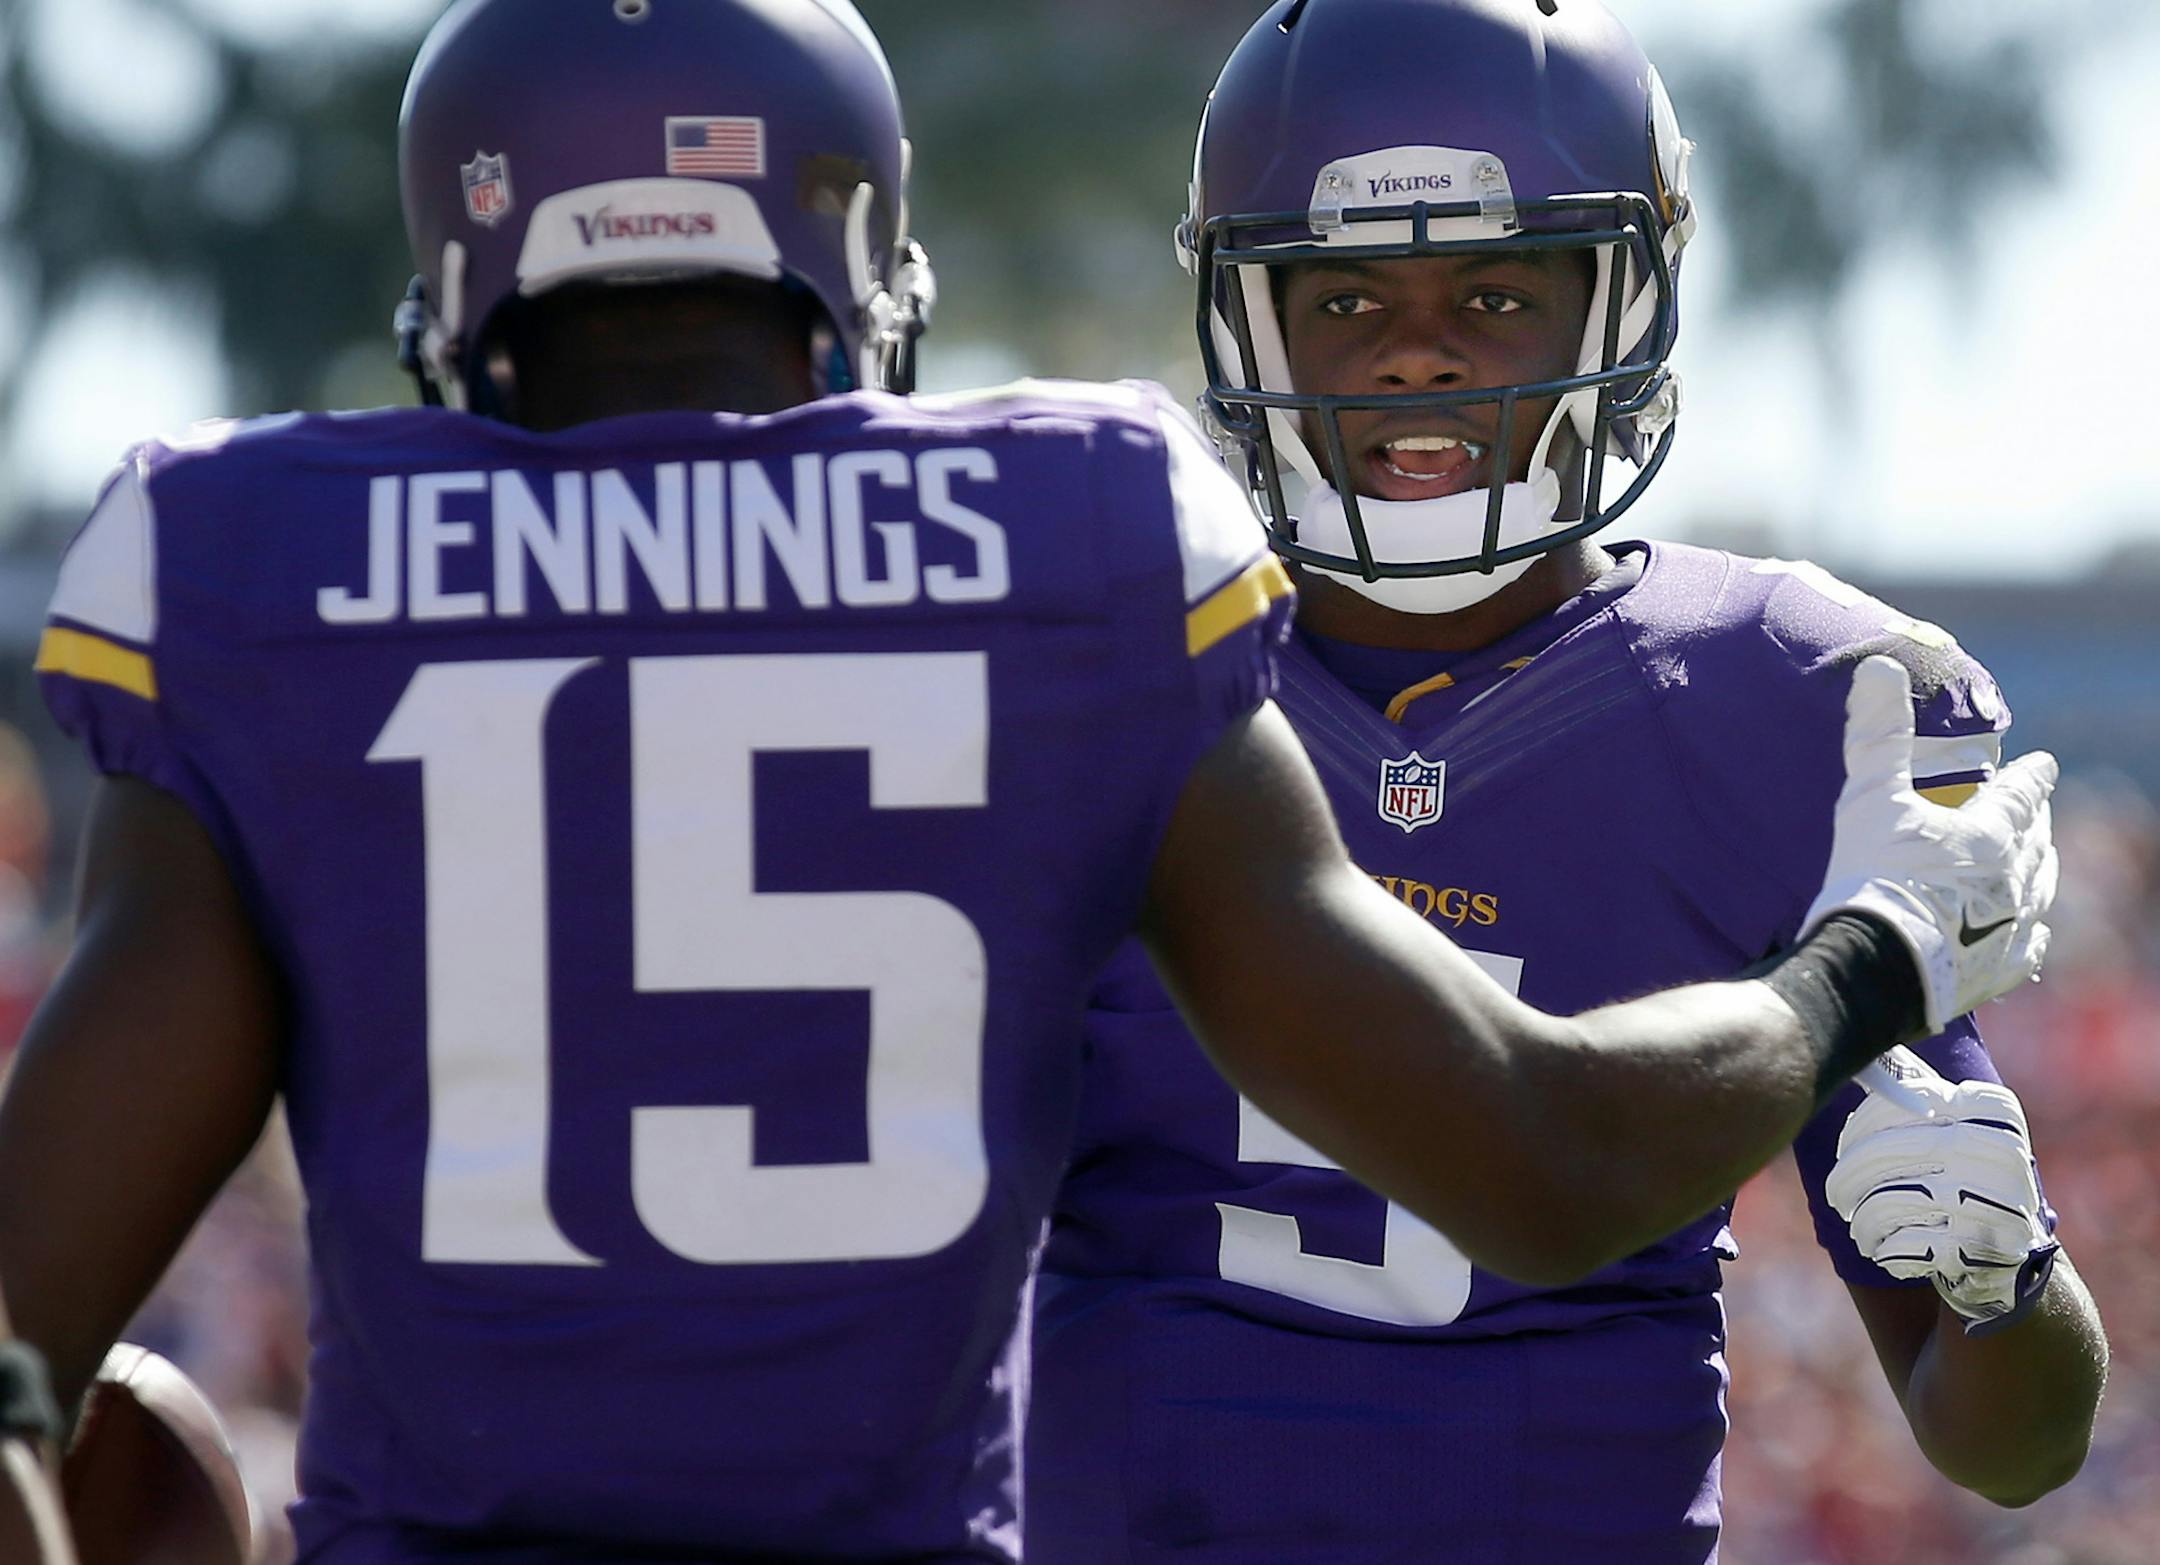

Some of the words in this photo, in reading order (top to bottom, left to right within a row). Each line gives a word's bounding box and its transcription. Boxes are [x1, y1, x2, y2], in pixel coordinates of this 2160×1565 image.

[469, 182, 506, 213] NFL
[1367, 169, 1452, 198] VIKINGS
[572, 203, 717, 246] VIKINGS
[316, 447, 1011, 625] JENNINGS
[1388, 786, 1433, 818] NFL
[1369, 874, 1499, 928] INGS
[364, 651, 990, 1267] 15
